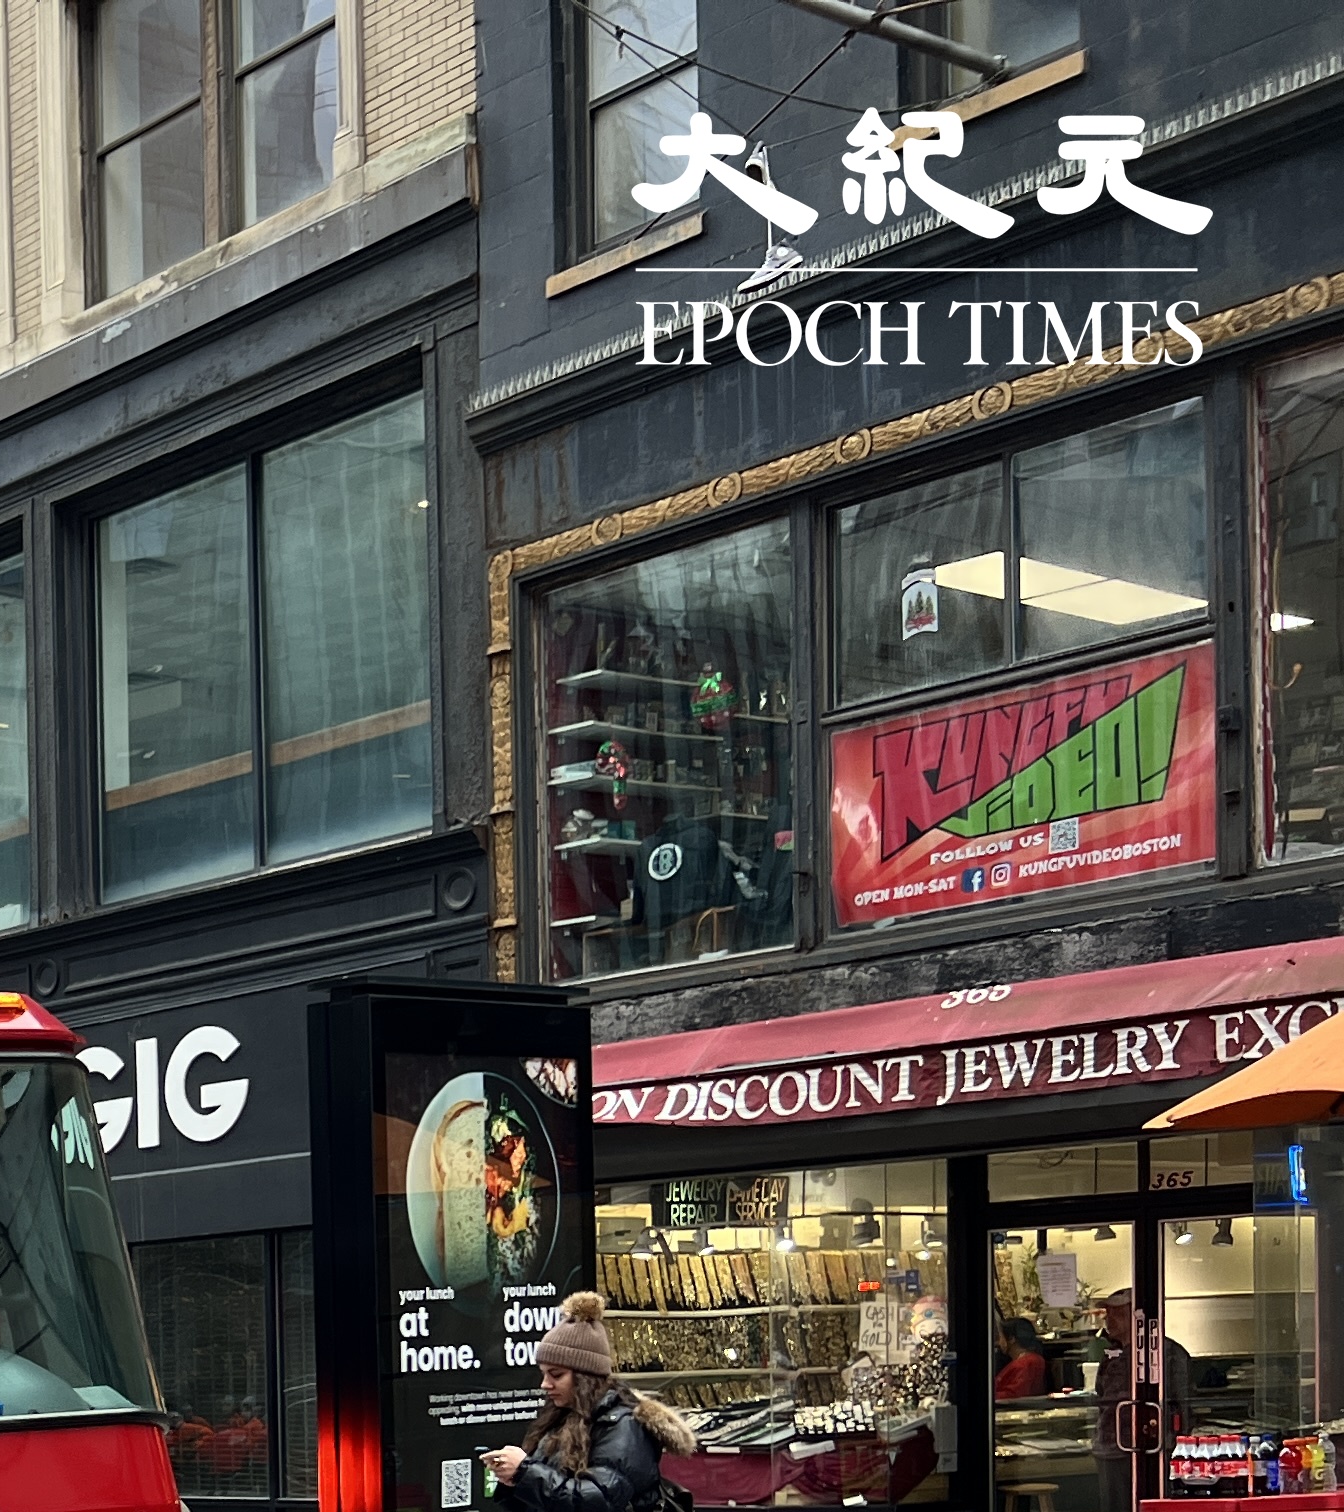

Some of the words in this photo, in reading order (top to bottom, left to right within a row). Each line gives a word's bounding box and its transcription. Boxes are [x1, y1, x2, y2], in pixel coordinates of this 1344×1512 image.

[873, 673, 1133, 862] KUNGFU
[929, 839, 1013, 867] FOLLLOW
[1019, 832, 1045, 849] US
[1018, 833, 1182, 878] KUNGFUVIDEOBOSTON
[854, 887, 890, 907] OPEN
[892, 876, 957, 902] MON-SAT
[655, 1055, 924, 1121] DISCOUNT
[936, 1019, 1190, 1106] JEWELRY
[1209, 997, 1344, 1065] EXC
[666, 1179, 726, 1202] JEWELRY
[1151, 1170, 1194, 1189] 365
[670, 1203, 718, 1226] REPAIR
[399, 1288, 425, 1305] your
[426, 1286, 454, 1301] lunch
[503, 1285, 526, 1301] your
[527, 1282, 556, 1297] lunch
[399, 1307, 429, 1337] at
[399, 1340, 481, 1373] home.
[1136, 1319, 1145, 1382] PULL
